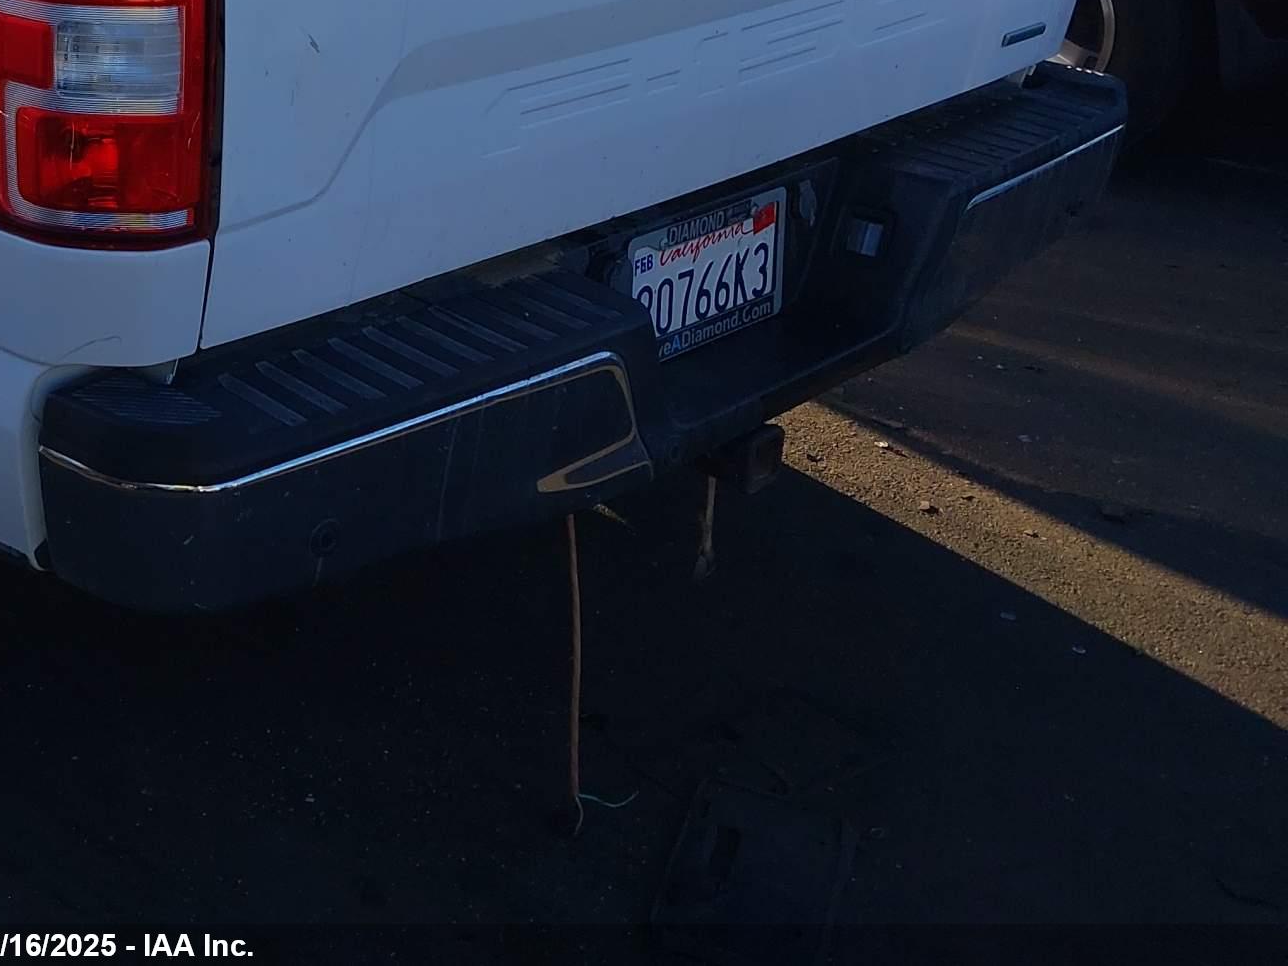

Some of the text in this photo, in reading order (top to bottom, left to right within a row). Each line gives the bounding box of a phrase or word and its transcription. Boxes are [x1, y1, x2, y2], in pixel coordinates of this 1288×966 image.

[659, 222, 753, 267] California
[667, 211, 726, 246] DIAMOND
[634, 254, 654, 277] FEB
